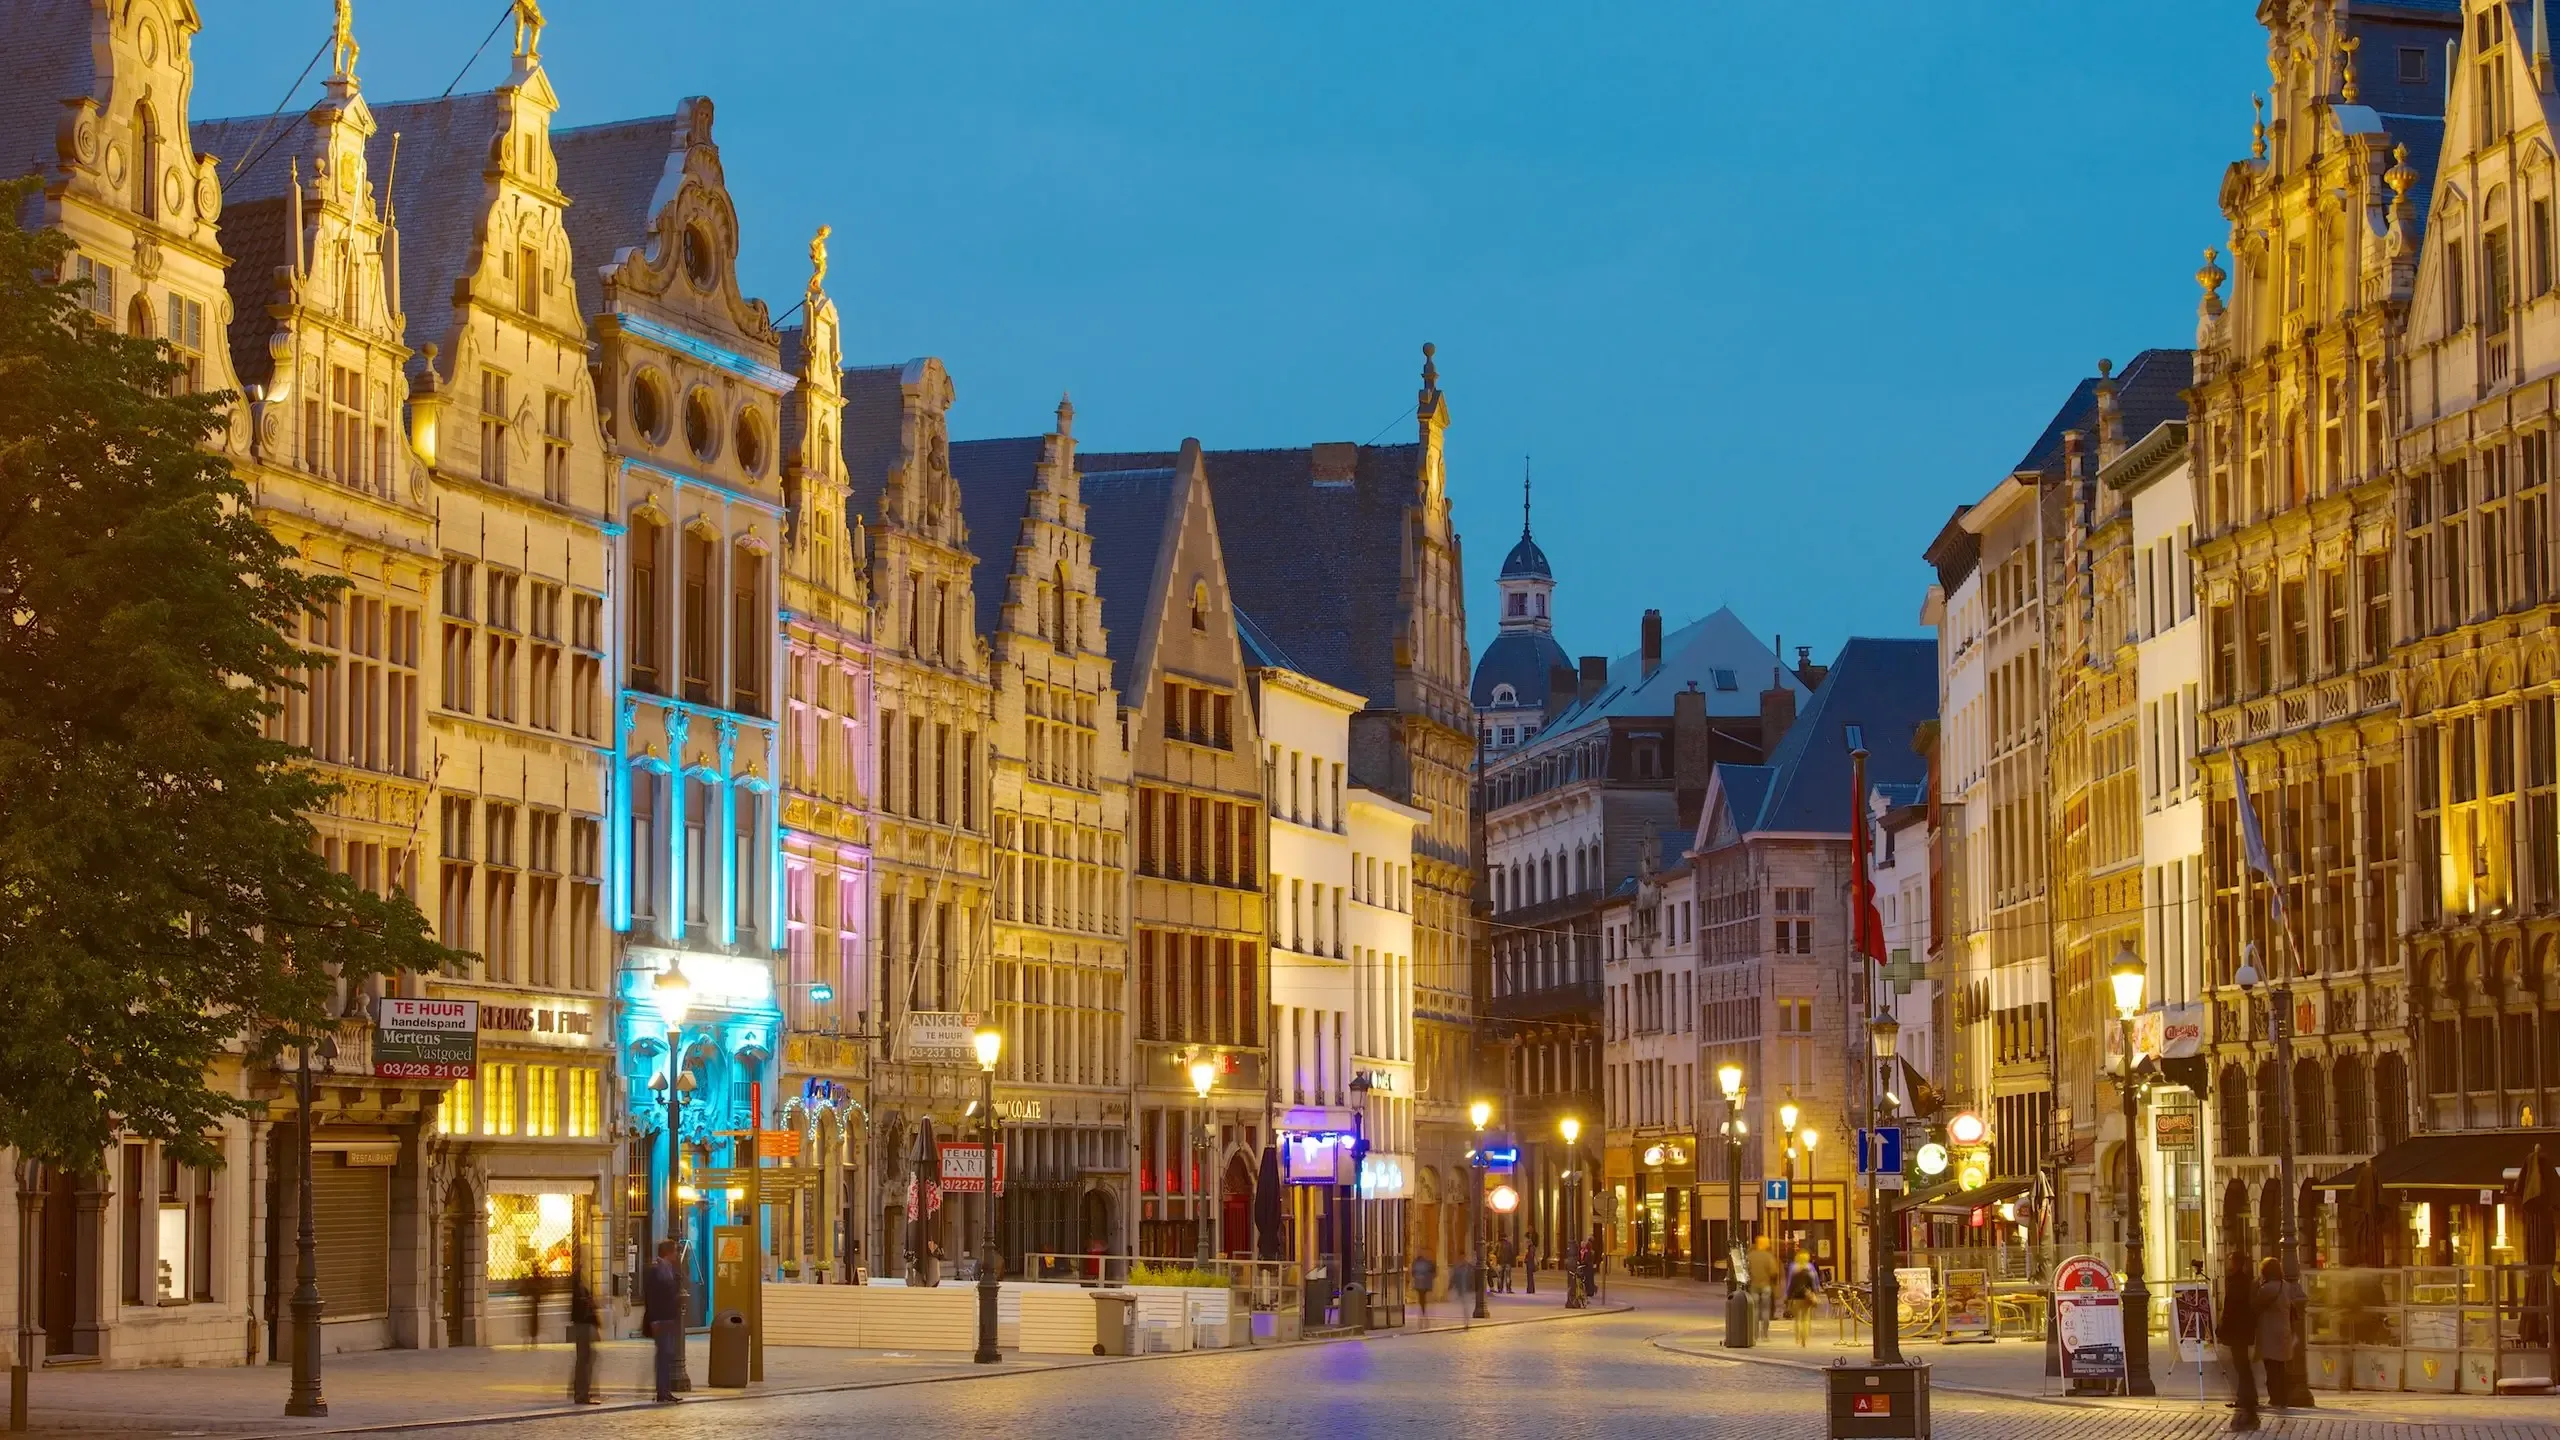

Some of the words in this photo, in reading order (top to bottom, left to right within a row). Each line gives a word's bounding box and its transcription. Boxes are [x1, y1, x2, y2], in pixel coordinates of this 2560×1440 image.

[1952, 962, 1964, 1034] TIMES
[395, 1002, 414, 1015] TE
[419, 1003, 465, 1017] HUUR
[391, 1017, 466, 1030] handelspand
[538, 1009, 554, 1033] IN
[558, 1011, 593, 1036] FINE
[911, 1014, 963, 1028] ANKER
[382, 1030, 441, 1045] Mertens
[926, 1031, 936, 1040] TE
[938, 1031, 963, 1040] HUUR
[415, 1046, 472, 1064] Vastgoed
[911, 1047, 946, 1058] 03-232
[950, 1047, 961, 1058] 18
[383, 1062, 430, 1076] 03/226
[434, 1064, 448, 1077] 21
[452, 1065, 469, 1078] 02
[1955, 1053, 1965, 1094] PUB
[946, 1149, 960, 1157] TE
[1858, 1398, 1868, 1410] A
